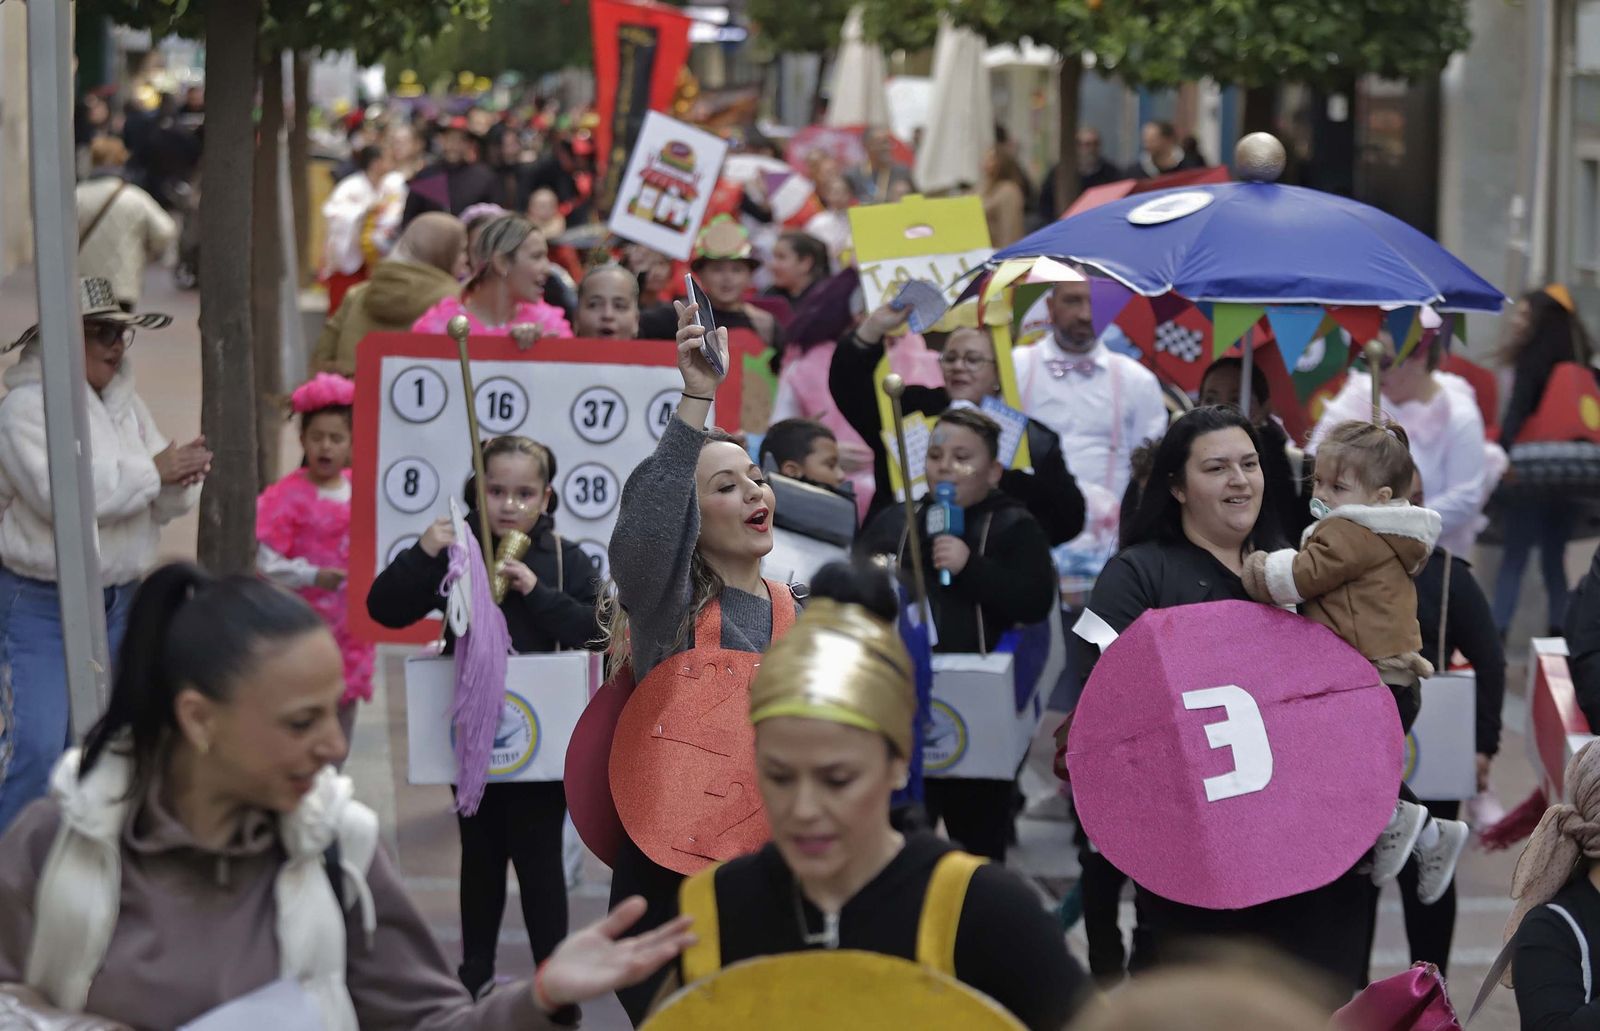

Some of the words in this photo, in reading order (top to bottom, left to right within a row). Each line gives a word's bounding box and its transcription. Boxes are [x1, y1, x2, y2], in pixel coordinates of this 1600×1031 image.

[414, 378, 425, 407] 1
[487, 391, 513, 420] 16
[583, 400, 616, 429] 37
[404, 467, 419, 497] 8
[575, 475, 606, 504] 38
[1182, 684, 1273, 802] 3
